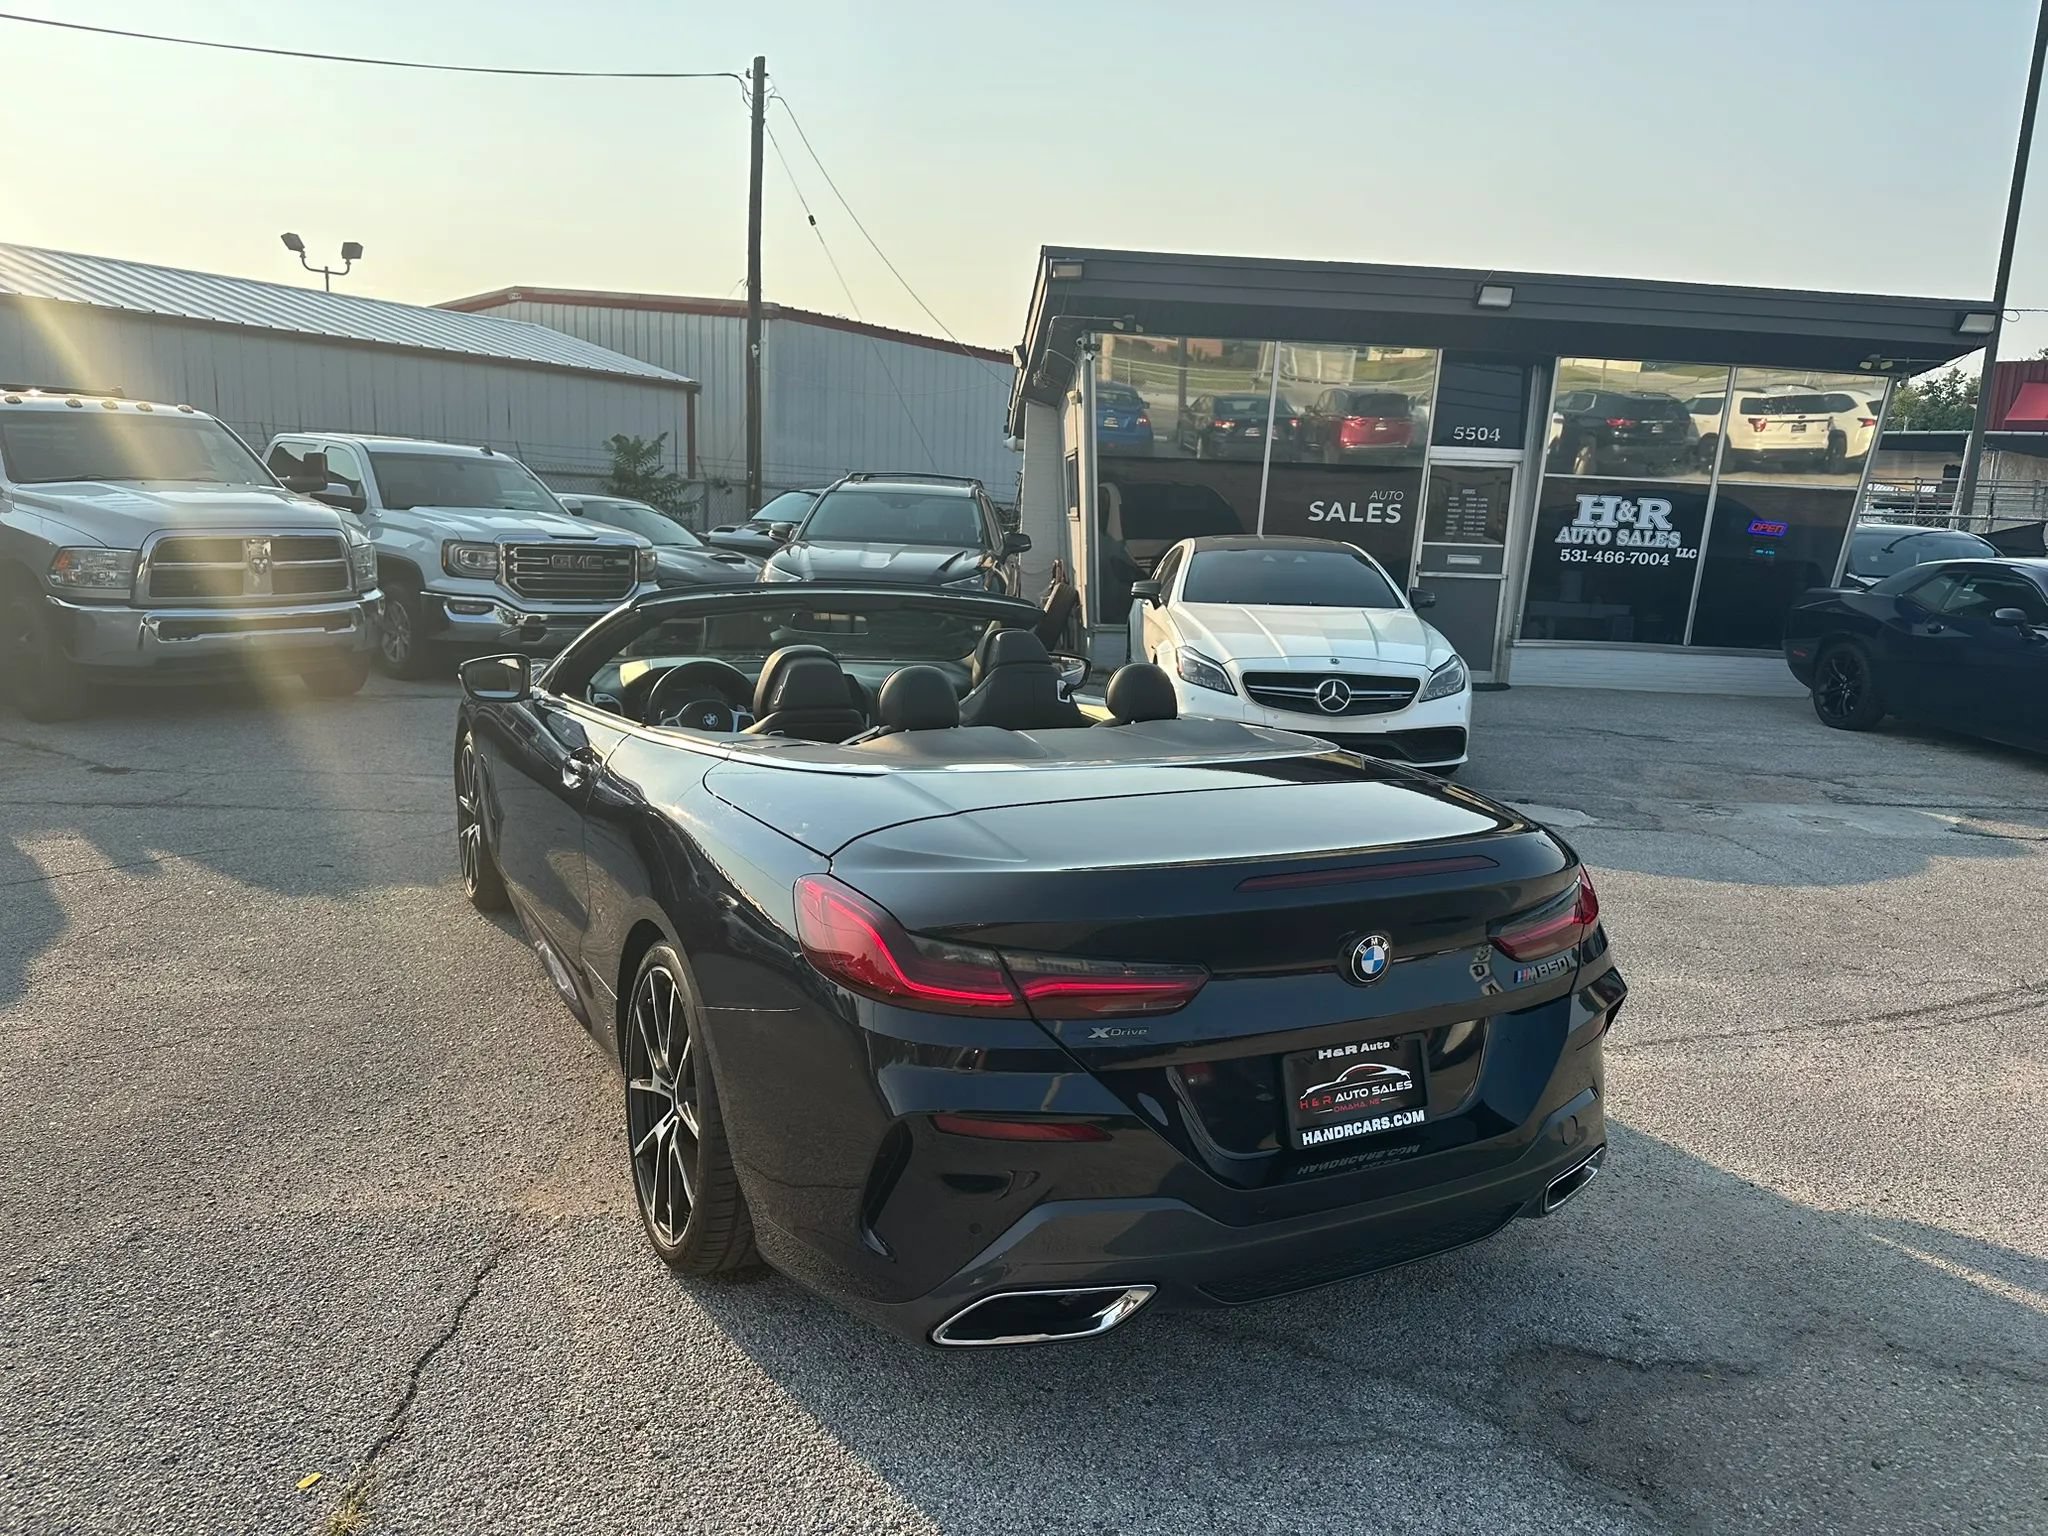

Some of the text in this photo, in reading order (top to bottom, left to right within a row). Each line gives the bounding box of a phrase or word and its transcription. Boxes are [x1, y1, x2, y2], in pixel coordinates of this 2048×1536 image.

[1453, 426, 1501, 442] 5504
[1369, 490, 1404, 501] AUTO
[1308, 501, 1402, 524] SALES
[1572, 494, 1673, 531] H&R
[1555, 526, 1682, 549] AUTO SALES
[551, 554, 604, 569] GMC
[1560, 549, 1670, 566] 531-466-7004
[1675, 547, 1698, 559] LLC
[1358, 937, 1390, 954] BMW
[1318, 1041, 1390, 1060] H&R Auto
[1300, 1080, 1413, 1110] H & R AUTO SALES
[1302, 1109, 1425, 1146] HANDRCARS.COM
